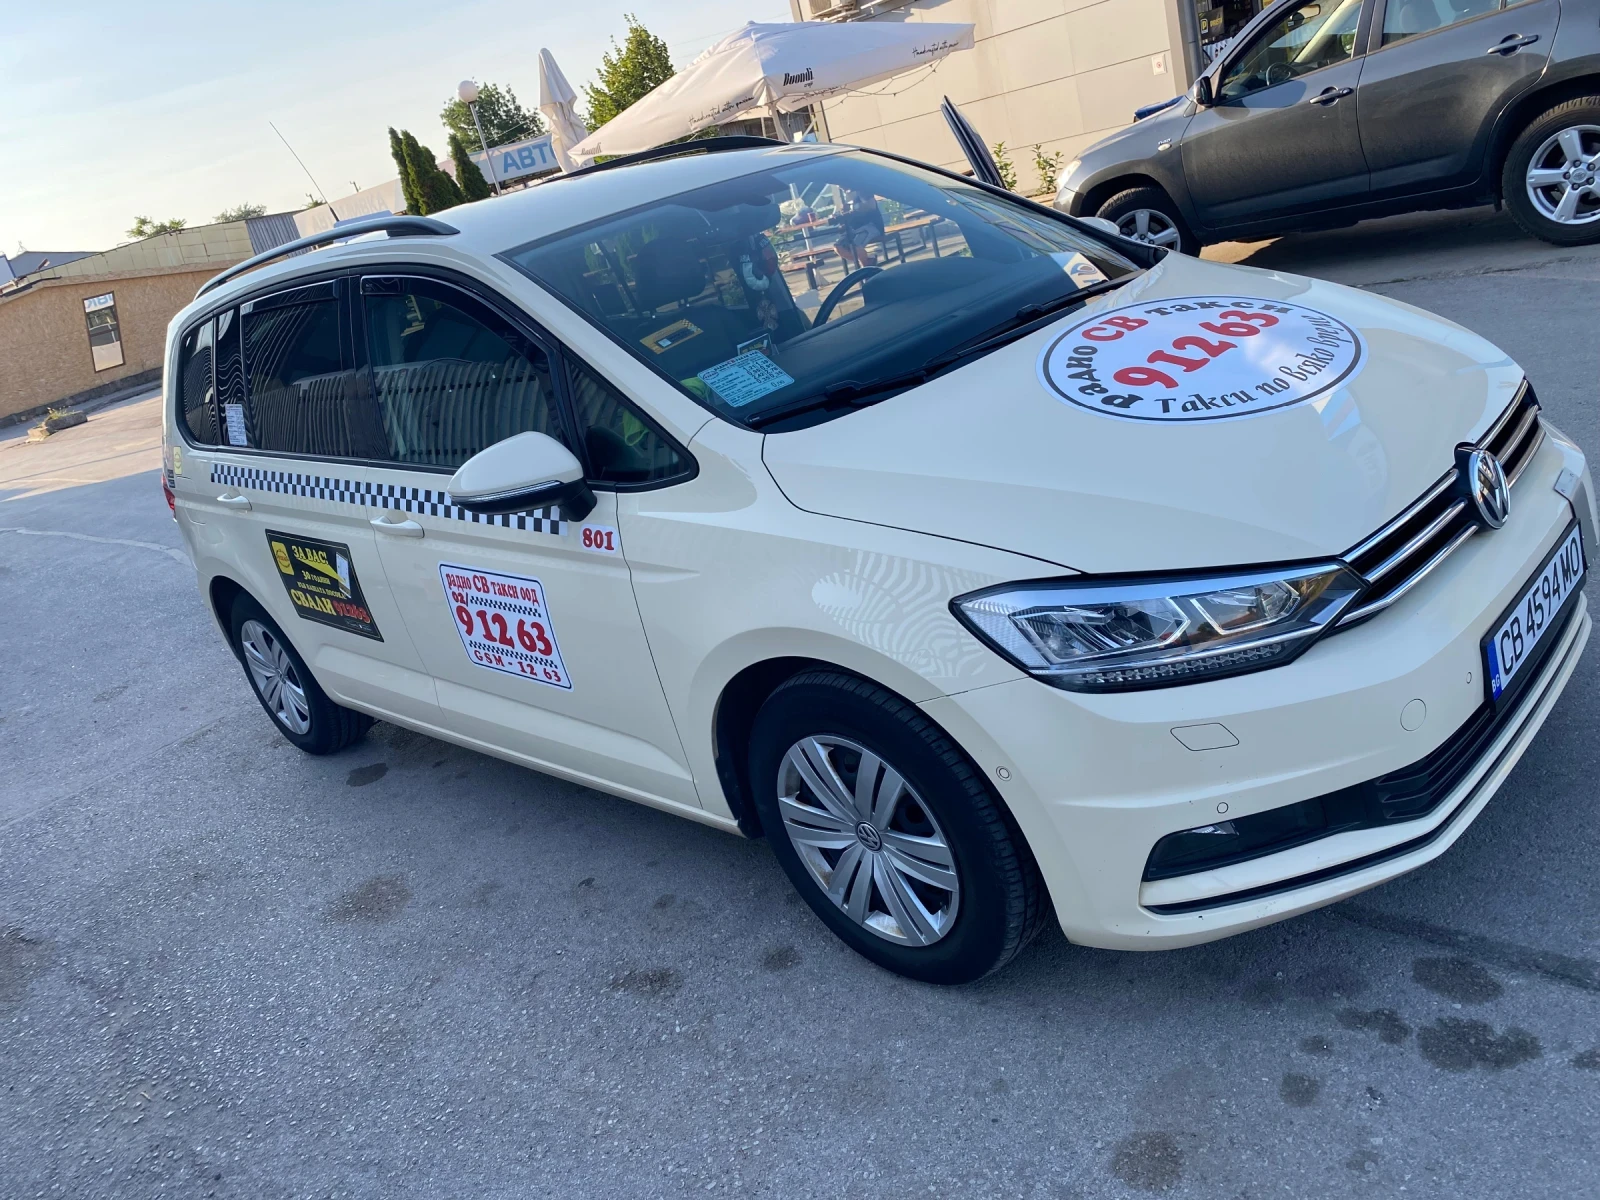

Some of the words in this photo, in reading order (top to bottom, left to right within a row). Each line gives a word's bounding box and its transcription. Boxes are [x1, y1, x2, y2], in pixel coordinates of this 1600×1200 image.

[1082, 315, 1149, 341] СВ
[1154, 387, 1259, 414] Такси
[1255, 376, 1291, 397] по
[582, 527, 615, 550] 801
[291, 545, 305, 560] ЗА
[445, 572, 472, 591] радио
[472, 574, 490, 594] СВ
[490, 581, 518, 599] такси
[520, 586, 539, 607] оод
[1526, 561, 1561, 639] 4594
[290, 588, 337, 616] СВАЛИ
[332, 600, 371, 624] 91263
[474, 649, 505, 667] GSM
[1491, 673, 1501, 693] BG
